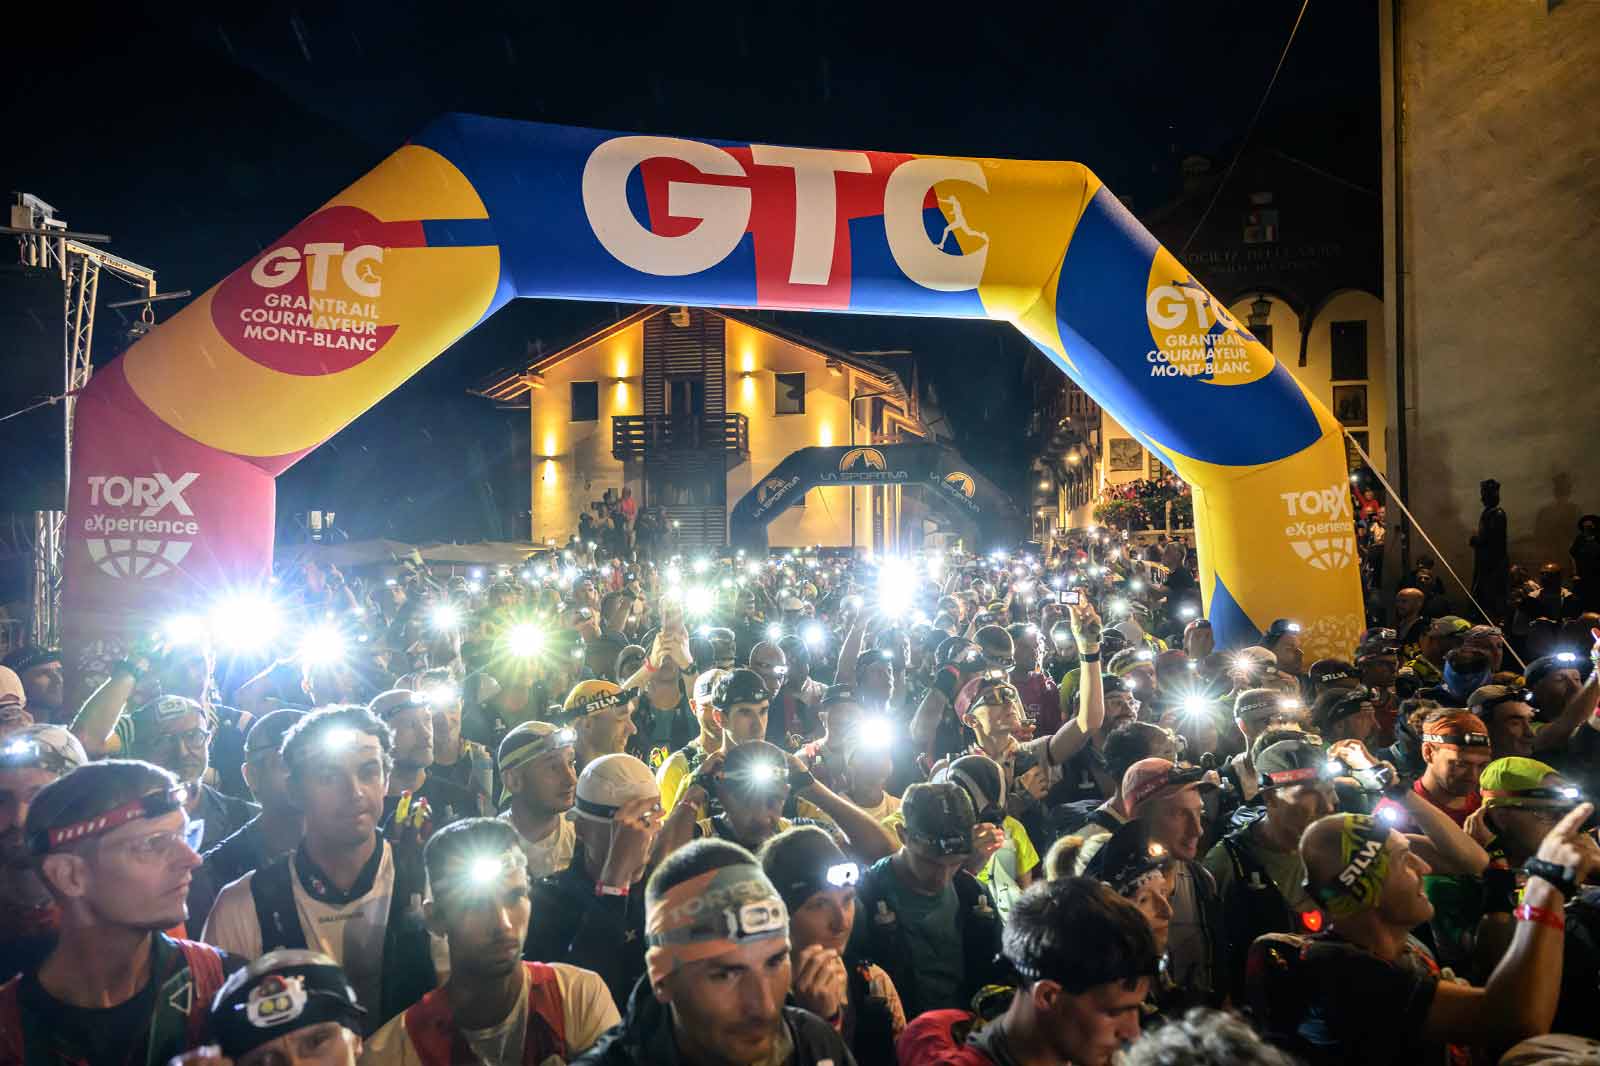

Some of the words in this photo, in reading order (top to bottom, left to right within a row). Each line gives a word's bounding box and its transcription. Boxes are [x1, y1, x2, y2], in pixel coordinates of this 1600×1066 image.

[582, 136, 989, 291] GTC
[251, 242, 384, 297] GTC
[264, 292, 379, 320] GRANTRAIL
[240, 308, 377, 336] COURMAYEUR
[243, 325, 377, 351] MONT-BLANC
[1165, 333, 1244, 347] GRANTRAIL
[1146, 348, 1248, 363] COURMAYEUR
[1150, 361, 1252, 377] MONT-BLANC
[840, 471, 909, 481] SPORTIVA
[88, 472, 200, 516] TORX
[84, 514, 200, 535] eXperience
[1321, 671, 1348, 682] SILVA
[586, 695, 620, 712] SILVA
[1339, 841, 1382, 886] SILVA
